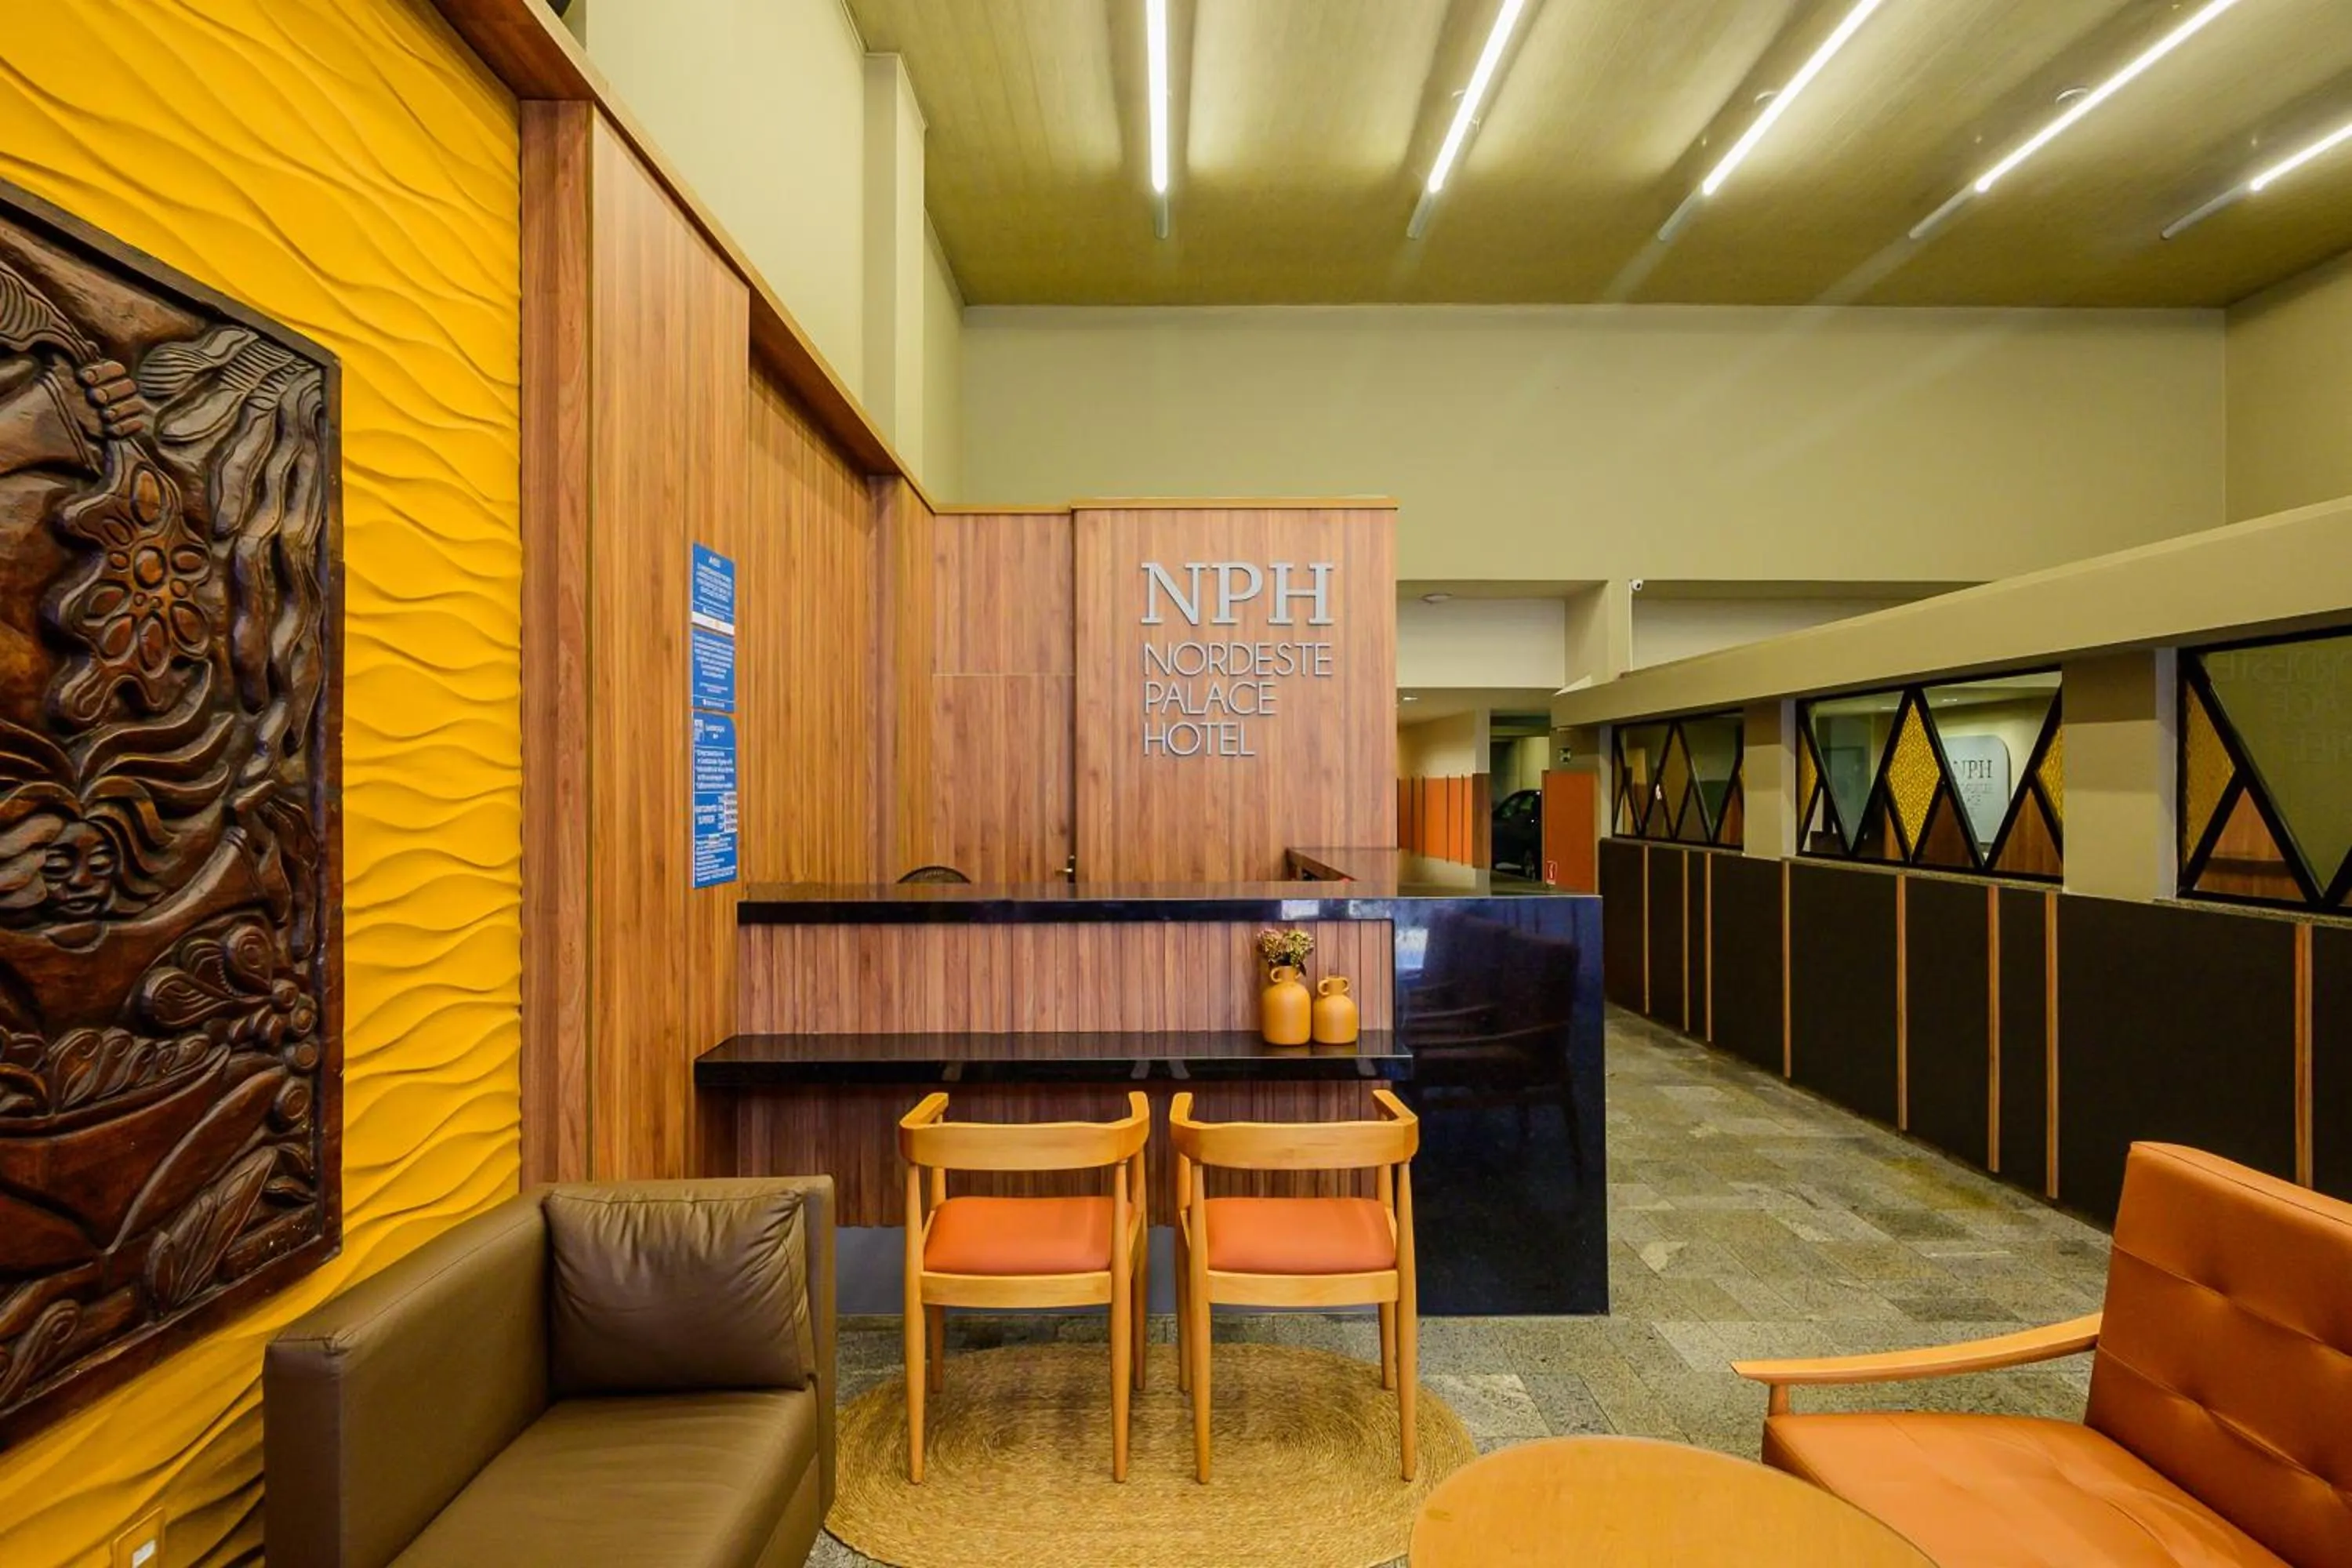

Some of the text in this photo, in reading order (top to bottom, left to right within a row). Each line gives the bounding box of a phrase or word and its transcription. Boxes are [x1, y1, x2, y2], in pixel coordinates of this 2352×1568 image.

[1141, 562, 1334, 625] NPH
[1142, 641, 1333, 677] NORDESTE
[1143, 681, 1278, 716] PALACE
[1142, 721, 1256, 757] HOTEL
